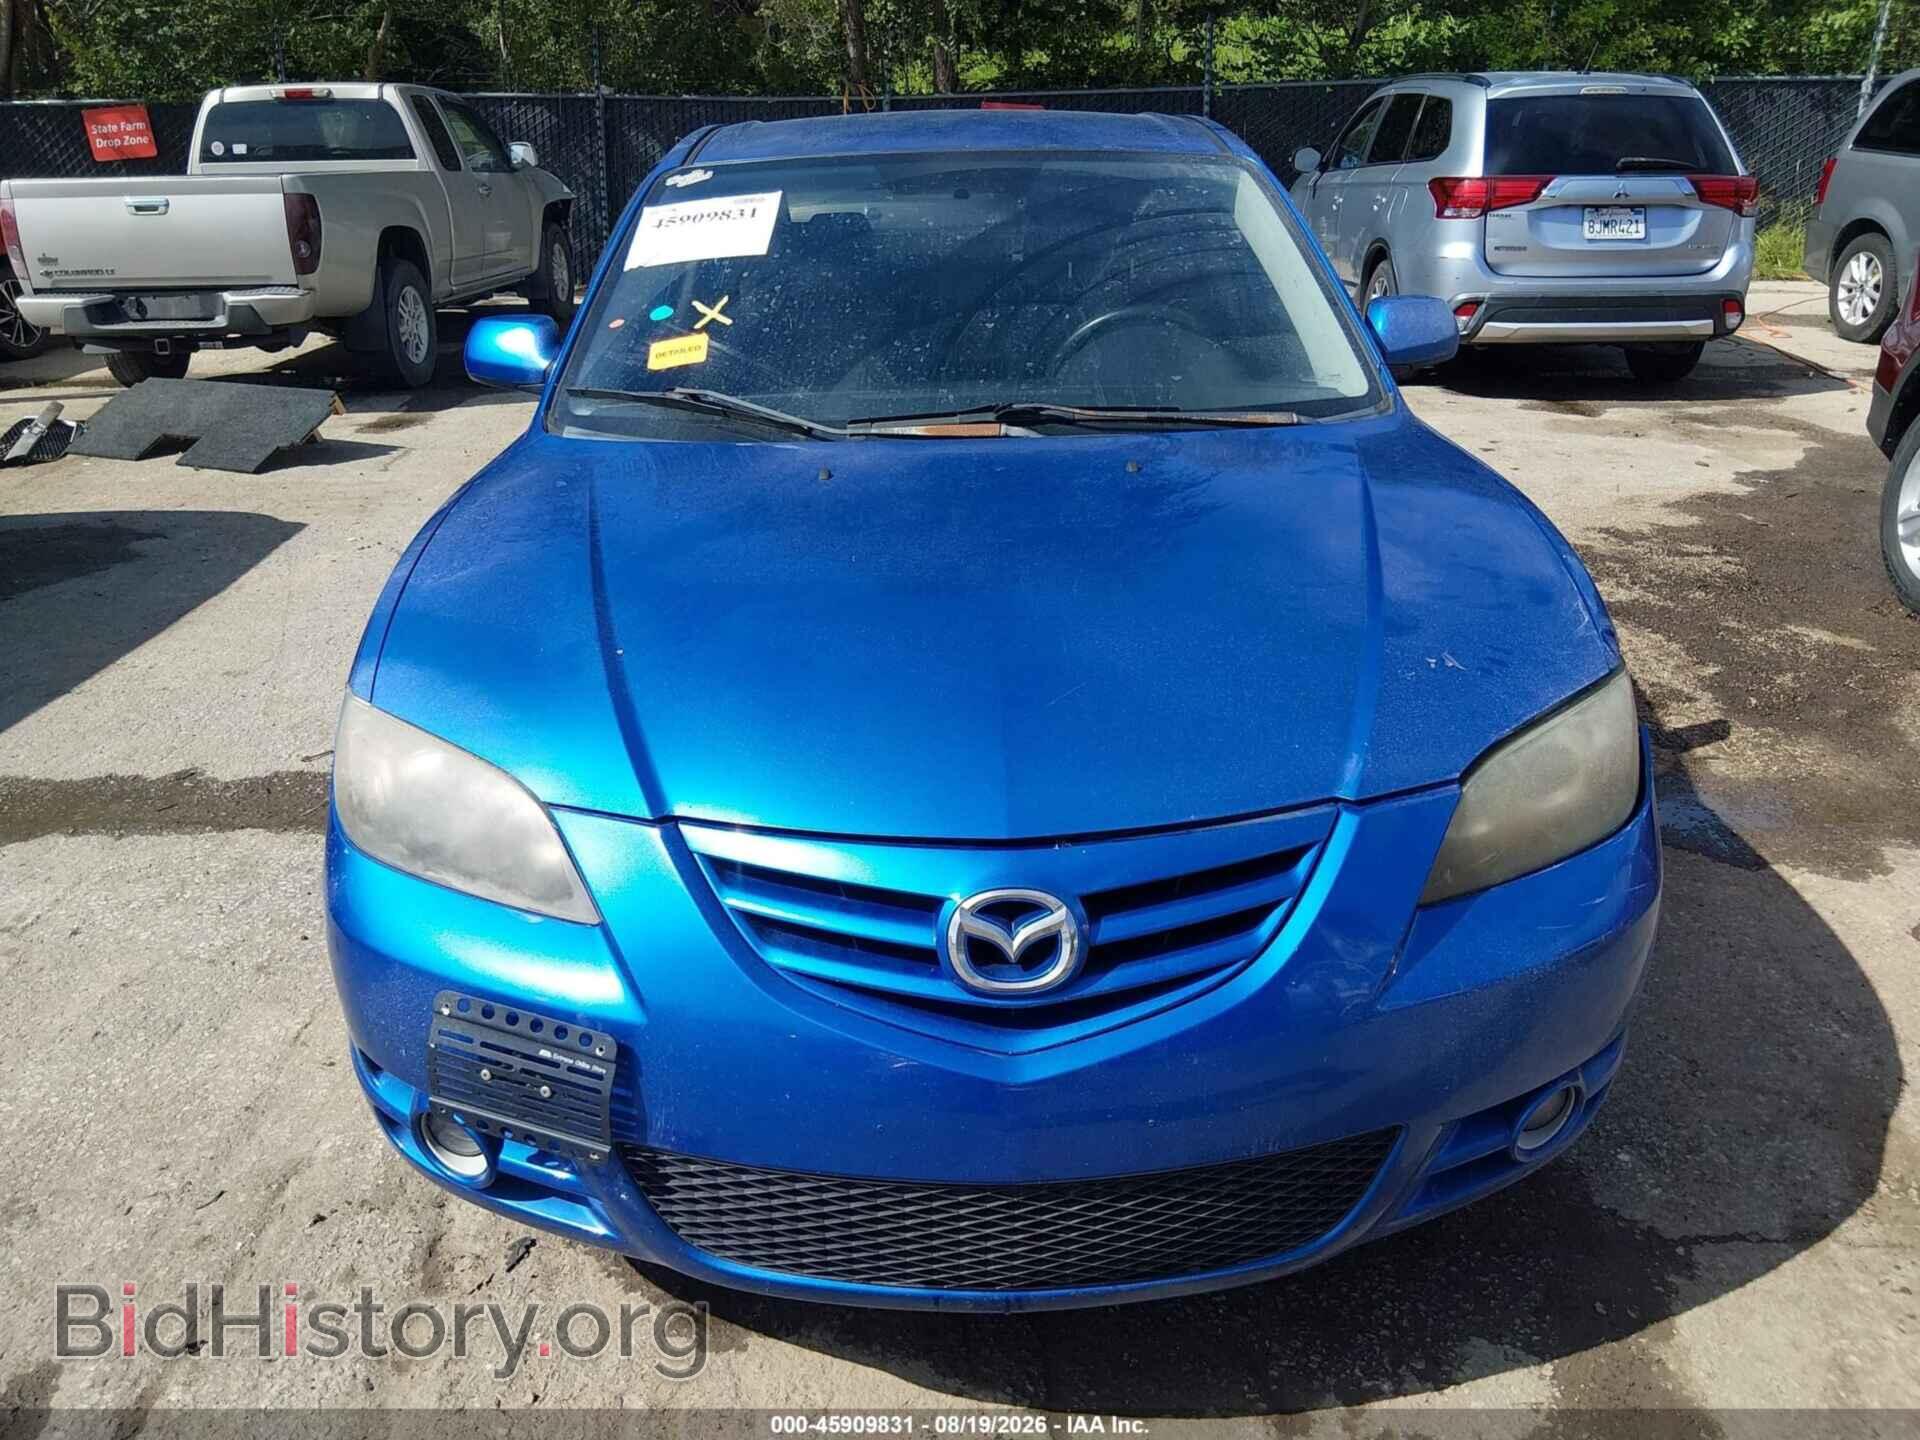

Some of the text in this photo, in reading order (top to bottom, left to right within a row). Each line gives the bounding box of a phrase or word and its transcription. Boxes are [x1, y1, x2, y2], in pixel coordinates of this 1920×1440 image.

[91, 121, 146, 135] State Farm
[96, 135, 150, 149] Drop Zone
[1588, 219, 1641, 234] 8JMR421
[655, 344, 702, 360] DETAILED
